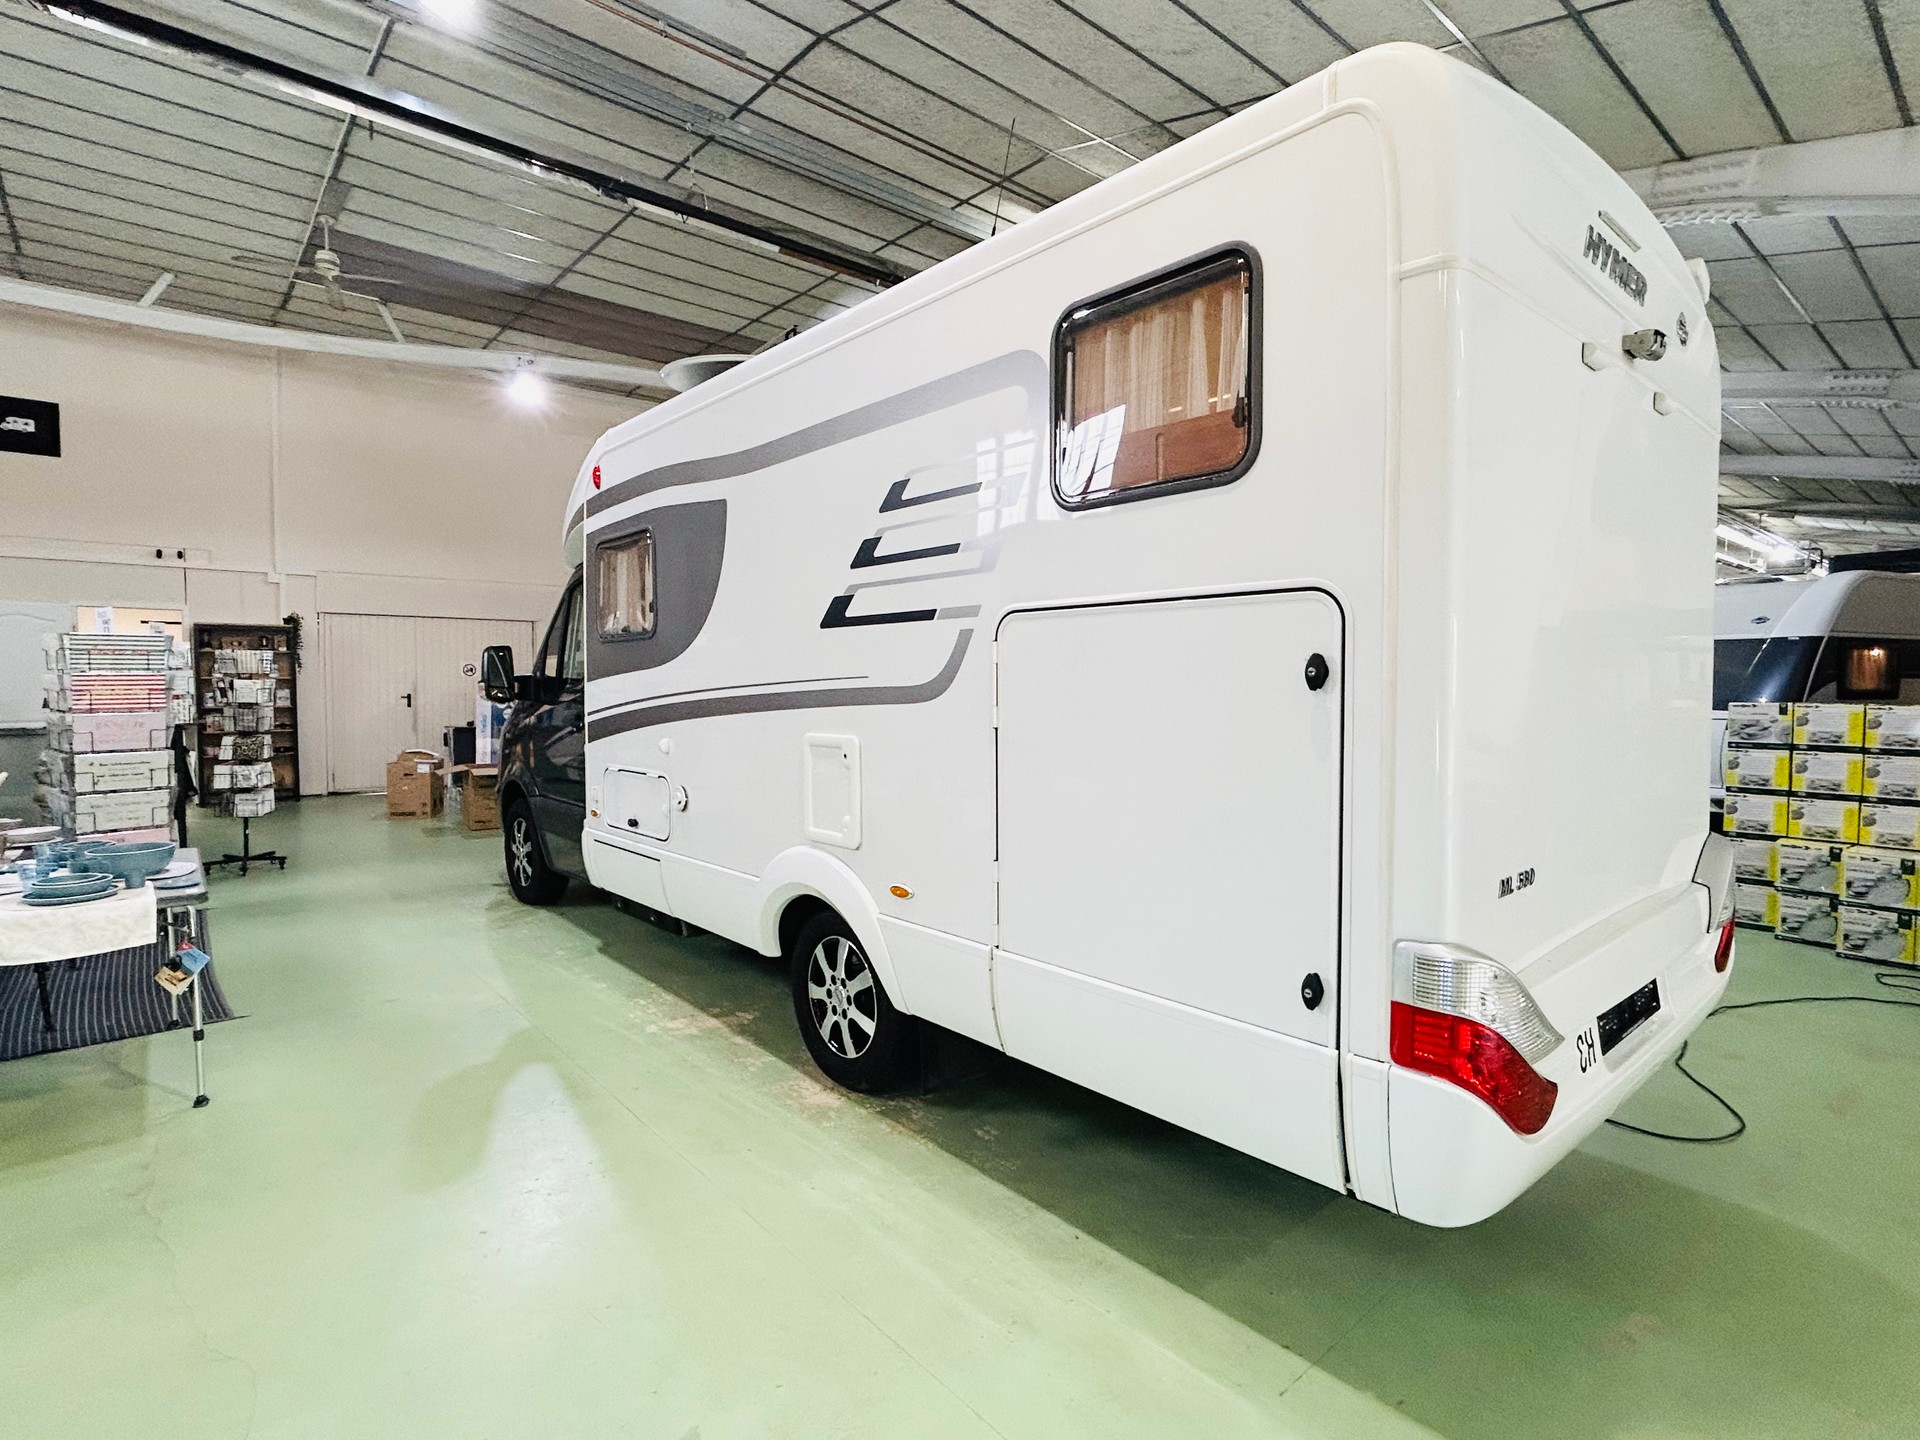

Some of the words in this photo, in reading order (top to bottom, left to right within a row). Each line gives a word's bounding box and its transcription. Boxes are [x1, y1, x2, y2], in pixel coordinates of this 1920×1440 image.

[1583, 224, 1648, 307] HYMER
[1498, 875, 1514, 899] ML
[1516, 867, 1536, 891] 580
